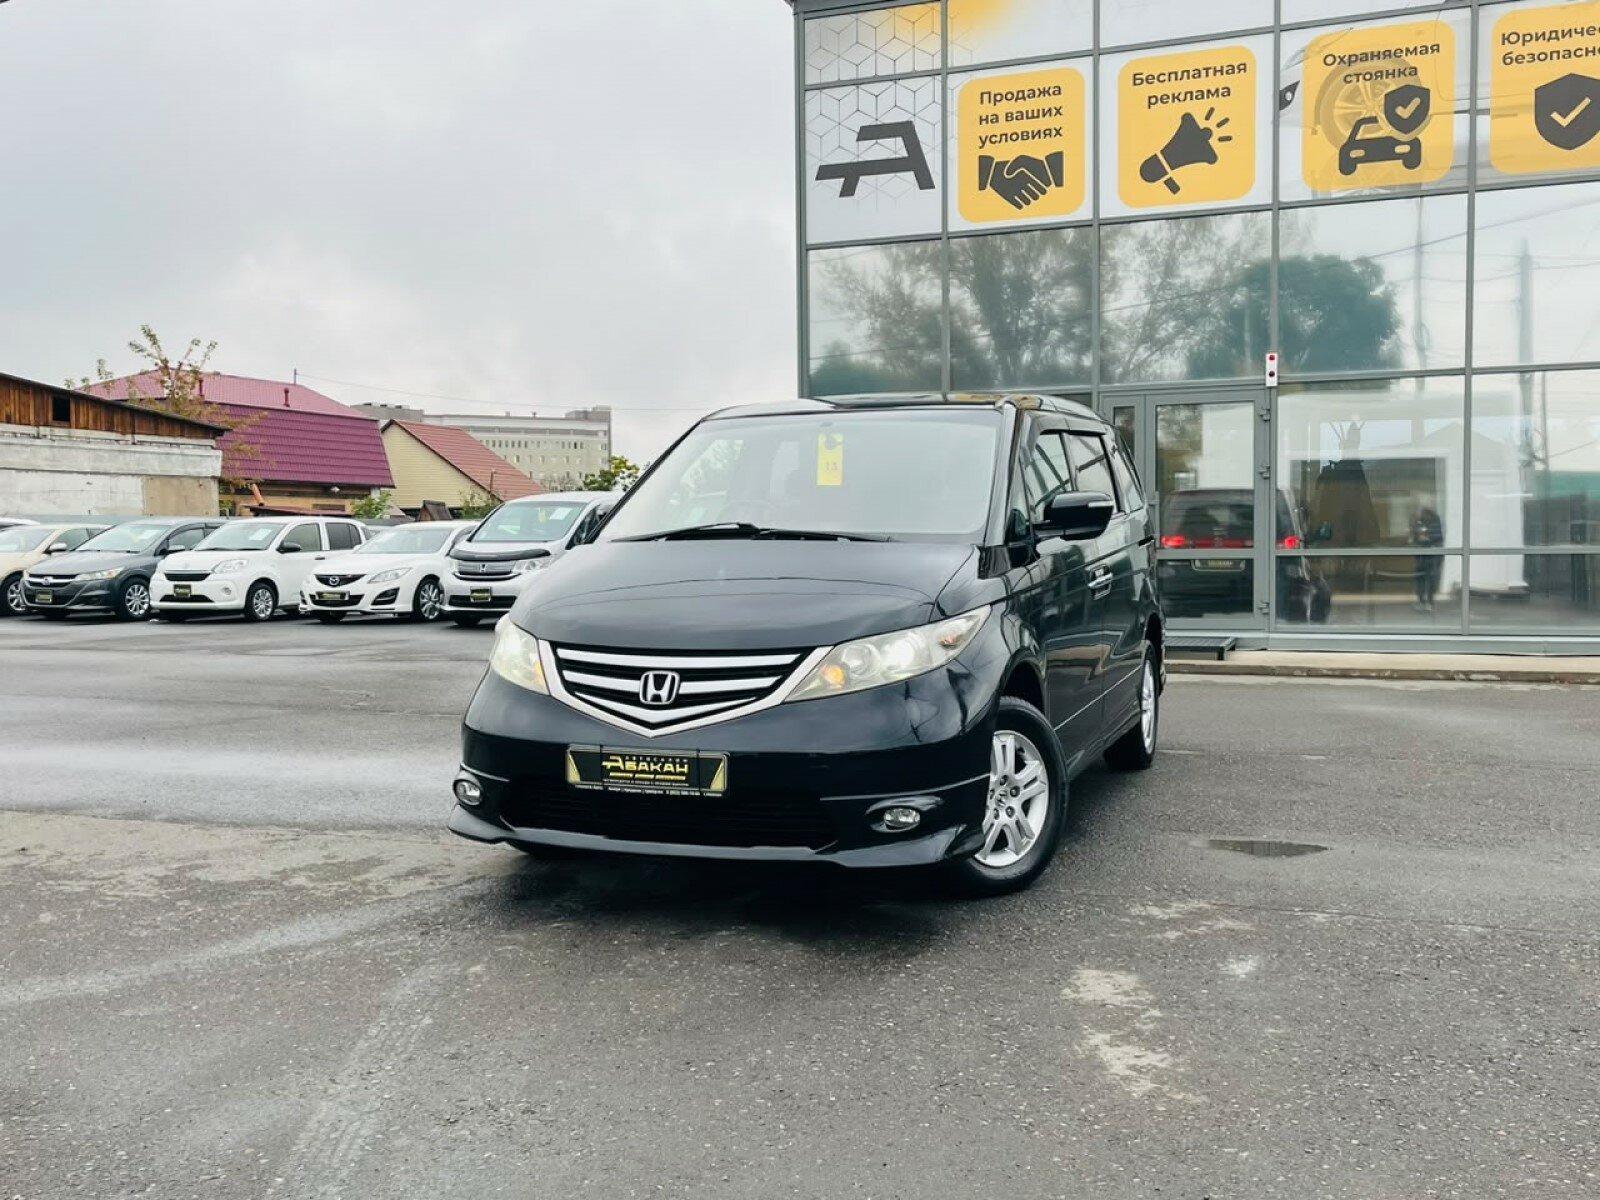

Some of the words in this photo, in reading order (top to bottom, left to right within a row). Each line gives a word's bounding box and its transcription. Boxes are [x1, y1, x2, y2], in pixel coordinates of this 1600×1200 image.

[1501, 25, 1600, 46] Юридиче
[1323, 43, 1440, 67] Охраняемая
[1132, 62, 1247, 86] Бесплатная
[1343, 66, 1418, 84] стоянка
[980, 85, 1062, 106] Продажа
[1147, 86, 1231, 109] реклама
[979, 113, 999, 125] на
[1005, 106, 1063, 122] ваших
[979, 127, 1063, 149] условиях
